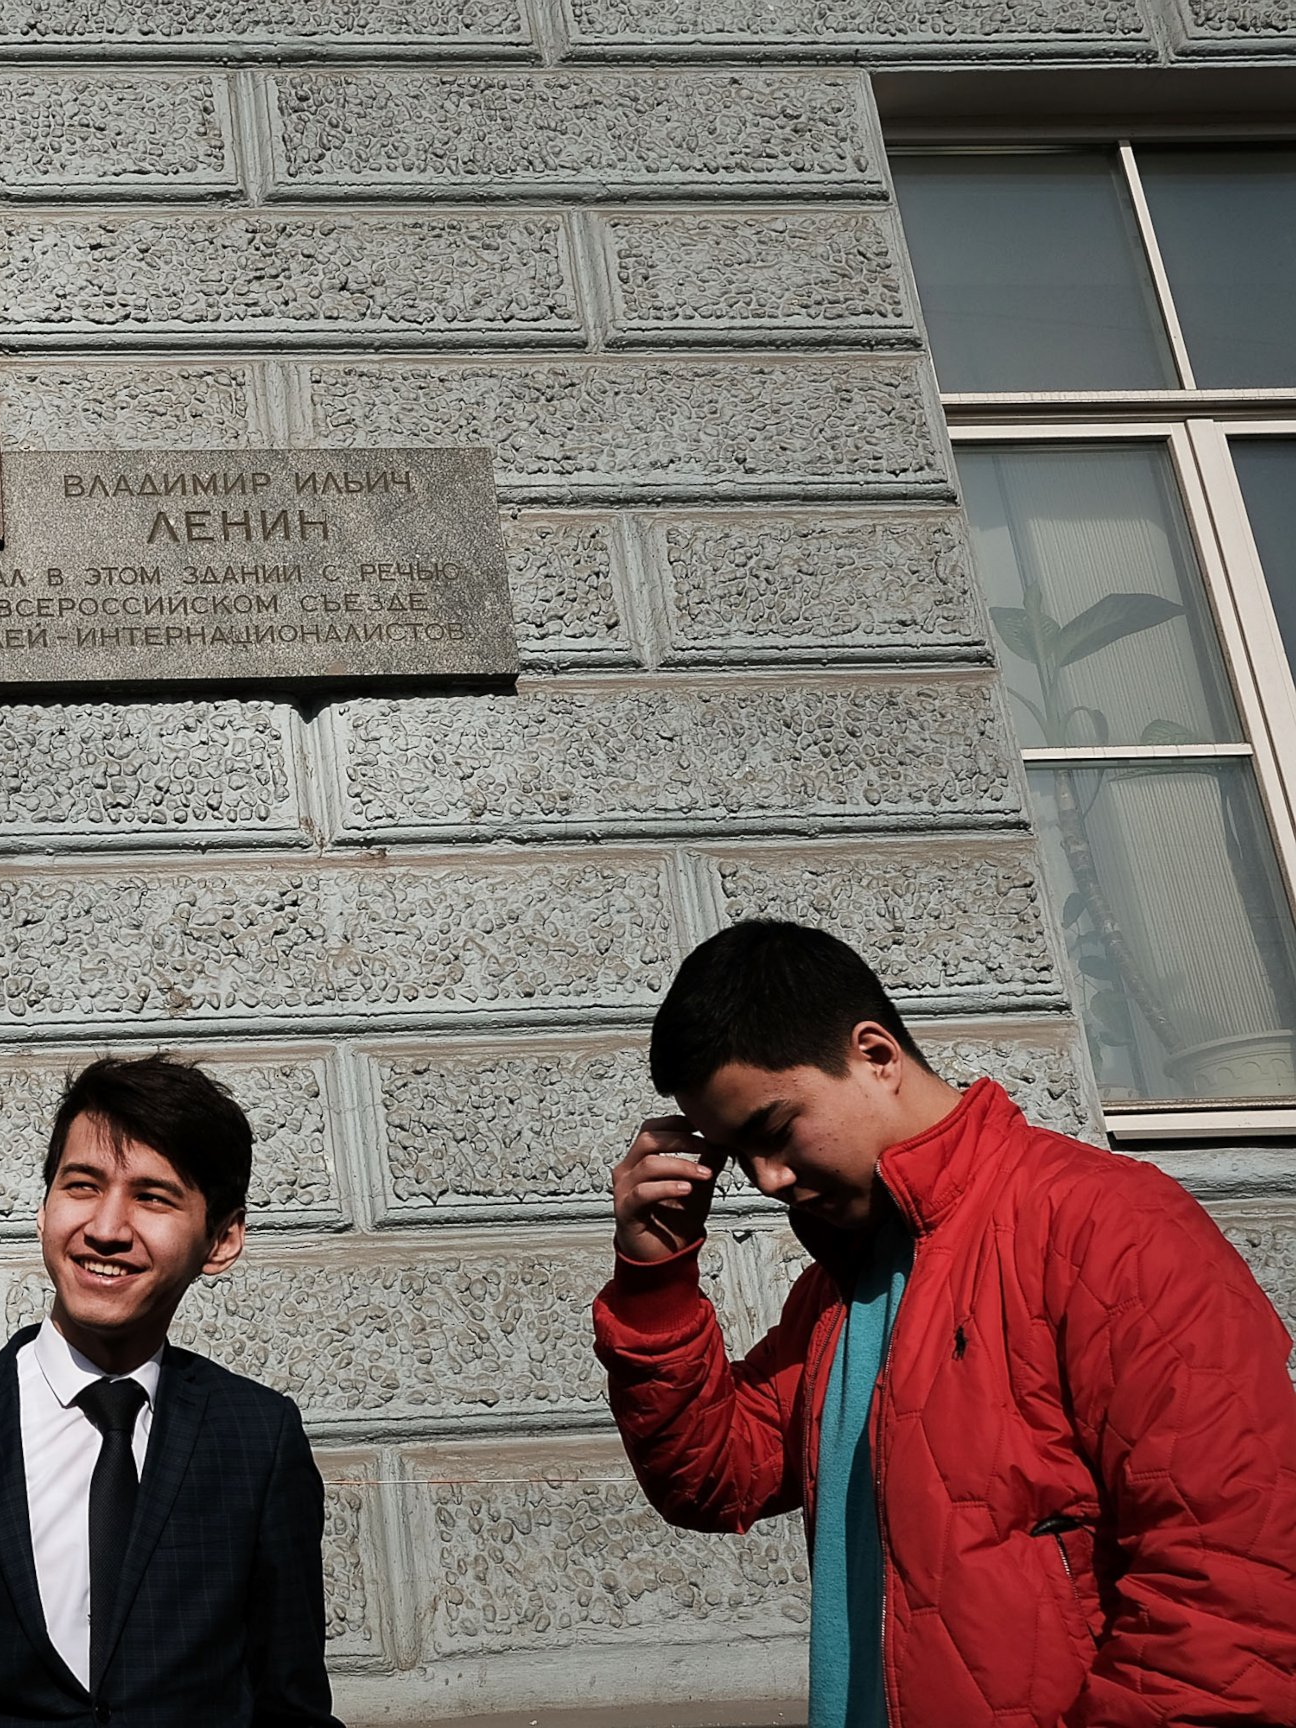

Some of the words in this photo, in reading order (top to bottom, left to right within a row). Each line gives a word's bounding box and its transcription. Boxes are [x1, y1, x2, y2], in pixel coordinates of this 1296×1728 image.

[63, 473, 272, 498] ВЛАДИМИР
[294, 471, 413, 496] ИЛЬИЧ
[146, 509, 330, 544] ЛЕНИН
[46, 567, 65, 587] В
[84, 565, 161, 587] ЭТОМ
[182, 564, 303, 585] ЗДАНИИ
[322, 563, 340, 583] С
[360, 562, 460, 583] РЕЧЬЮ
[301, 593, 430, 614] СЪЕЗДЕ
